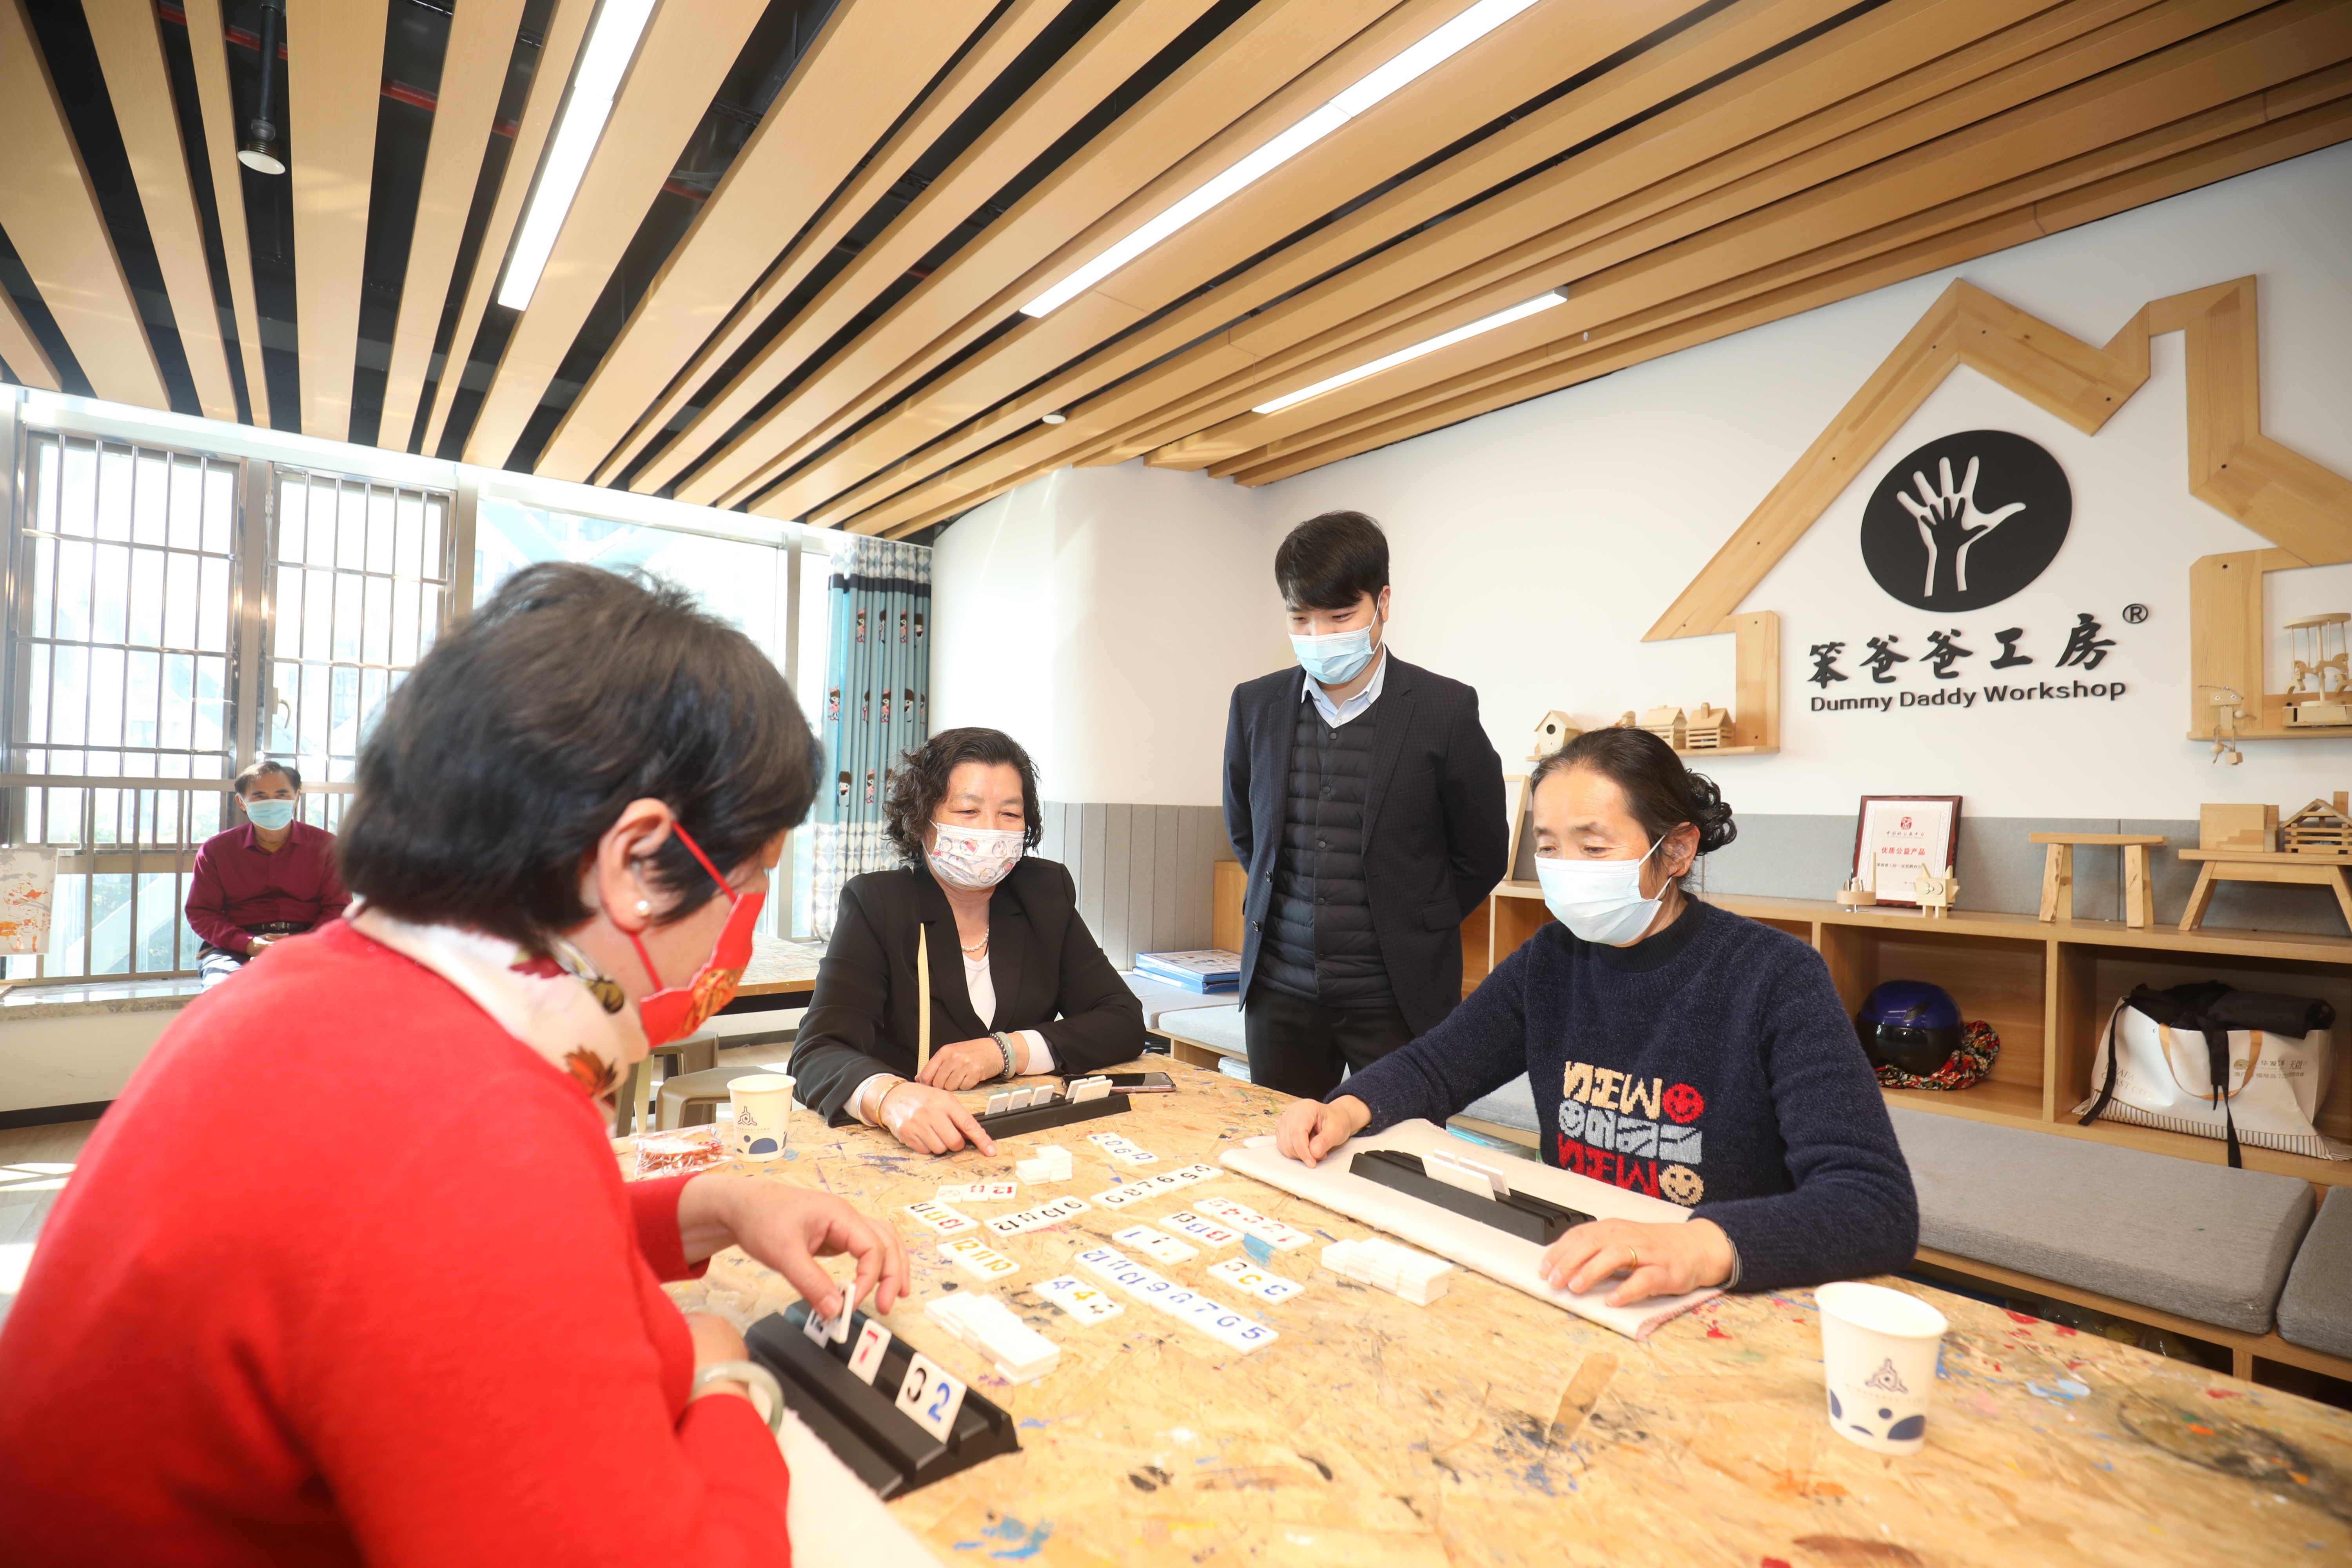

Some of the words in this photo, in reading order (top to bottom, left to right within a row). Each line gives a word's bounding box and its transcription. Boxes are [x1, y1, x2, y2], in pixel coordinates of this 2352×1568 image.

[1807, 613, 2117, 689] 笨爸爸工房
[1810, 695, 1893, 712] Dummy
[1900, 686, 1977, 708] Daddy
[1985, 680, 2127, 703] Workshop
[1881, 846, 1925, 855] 优质公益产品
[1563, 1061, 1663, 1120] NEW
[993, 1186, 1013, 1194] 12
[938, 1219, 965, 1229] 13
[1171, 1213, 1197, 1223] 13
[1185, 1223, 1211, 1234] 13
[1205, 1230, 1232, 1241] 13
[951, 1239, 980, 1252] 12
[969, 1250, 996, 1261] 11
[983, 1259, 1012, 1272] 10
[1051, 1281, 1076, 1290] 4
[1073, 1291, 1097, 1301] 4
[1082, 1250, 1111, 1263] 12
[1107, 1259, 1134, 1271] 11
[1241, 1327, 1268, 1340] 5
[1238, 1274, 1262, 1285] 3
[1264, 1285, 1288, 1296] 3
[927, 1382, 951, 1424] 2
